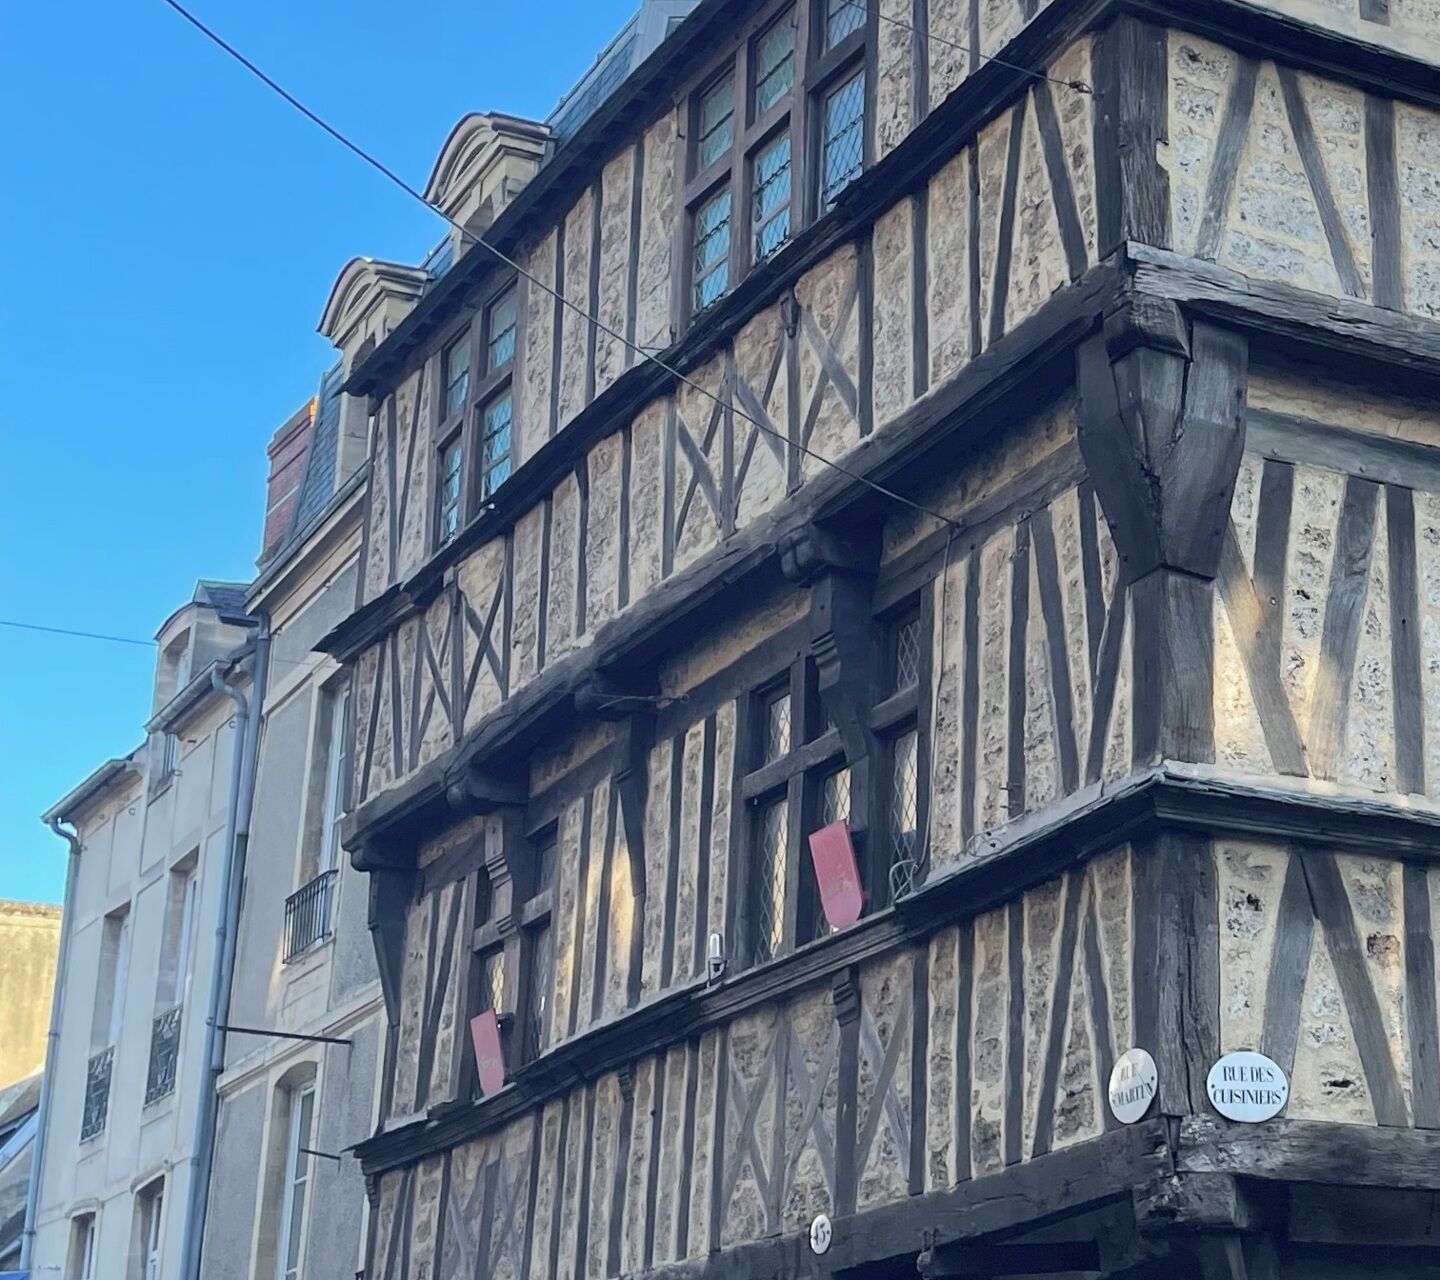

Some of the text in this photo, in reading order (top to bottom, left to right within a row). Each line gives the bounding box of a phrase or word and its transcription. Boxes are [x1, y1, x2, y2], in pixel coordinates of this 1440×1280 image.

[1223, 1066, 1275, 1083] RUE DES
[1213, 1089, 1282, 1106] CUISINIERS
